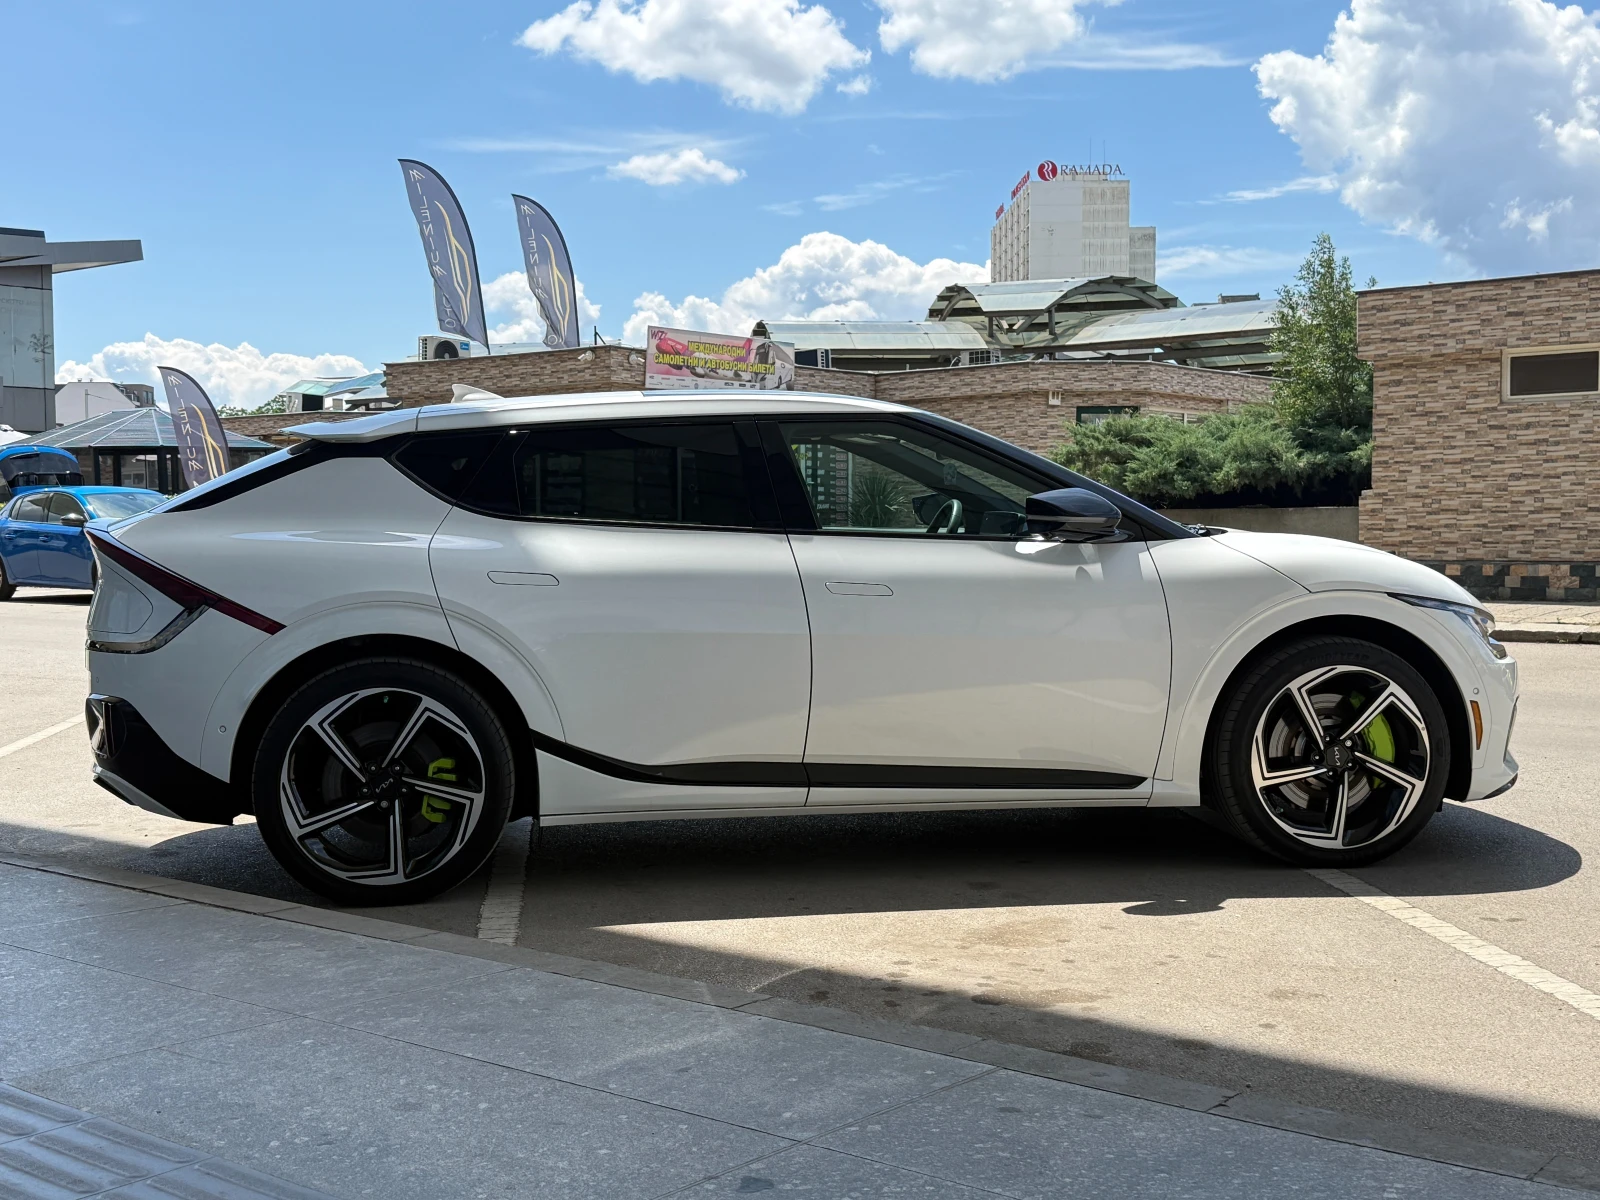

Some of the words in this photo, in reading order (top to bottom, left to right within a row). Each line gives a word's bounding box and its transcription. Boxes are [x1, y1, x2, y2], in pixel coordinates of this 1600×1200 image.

[1060, 164, 1123, 176] RAMADA
[688, 341, 746, 358] МЕЖДУНАРОДНИ
[654, 353, 699, 367] САМОЛЕТНИ
[699, 358, 706, 367] И
[706, 359, 747, 372] АВТОБУСНИ
[748, 363, 776, 375] БИЛЕТИ
